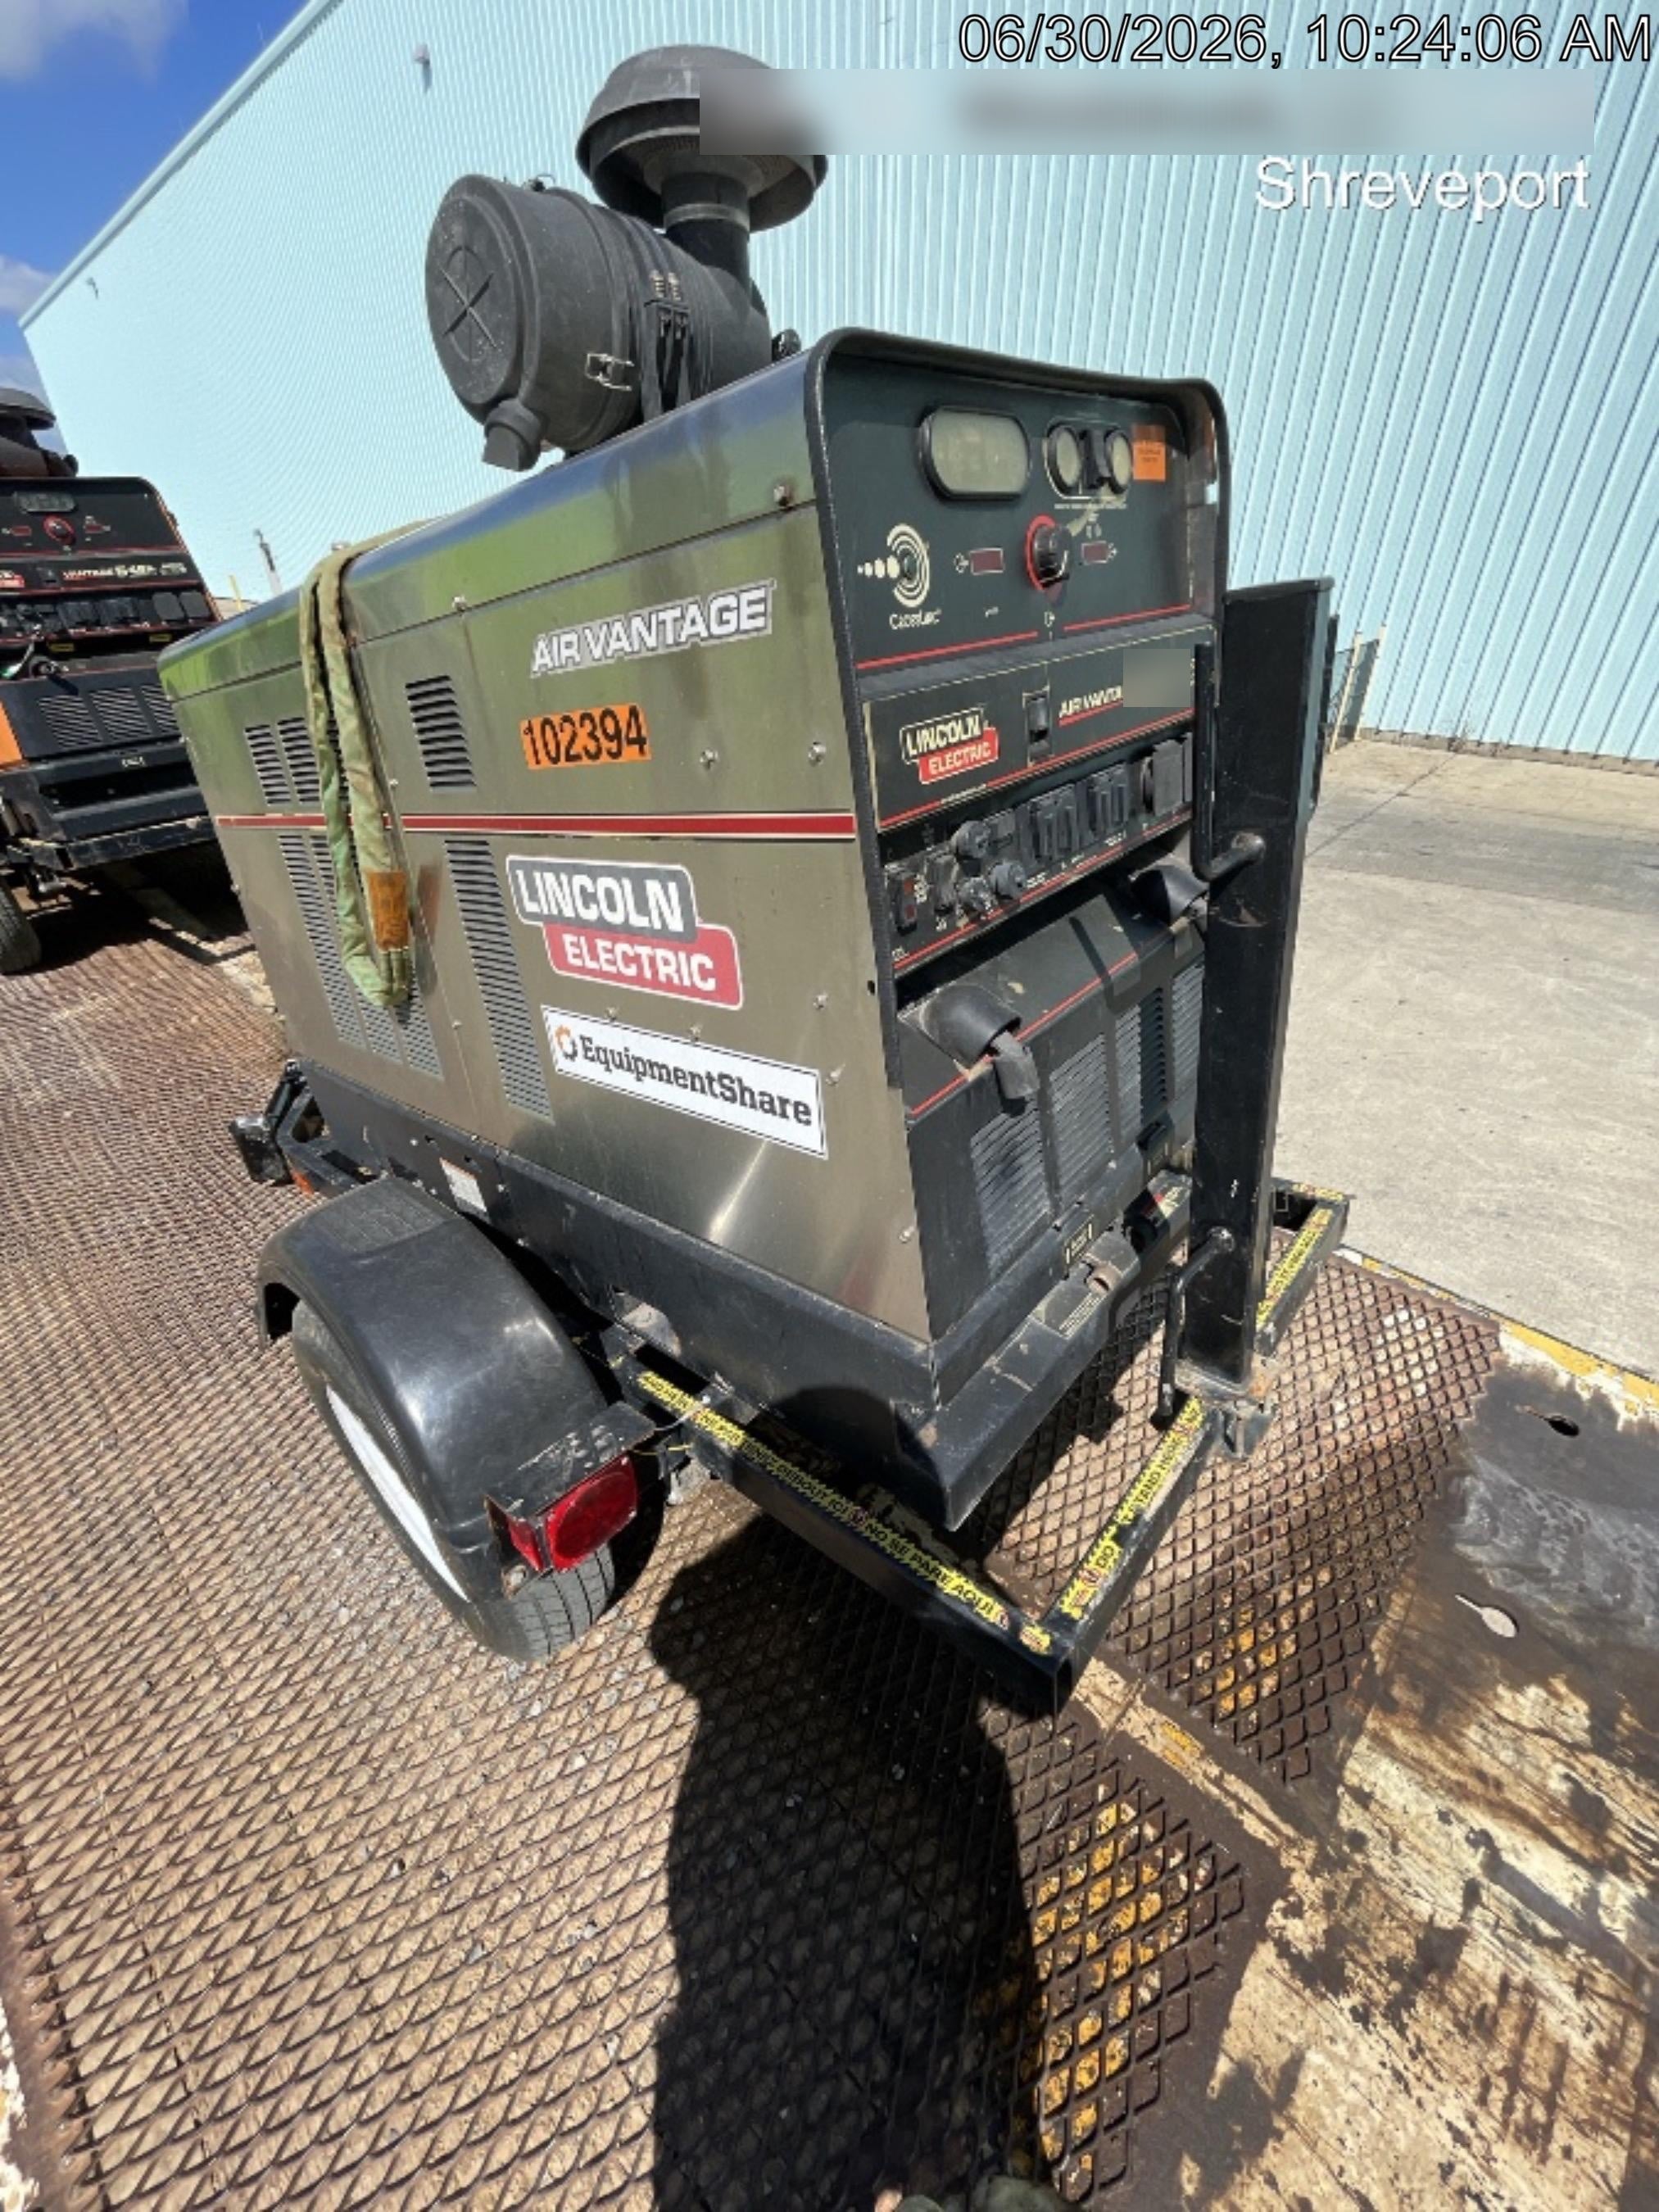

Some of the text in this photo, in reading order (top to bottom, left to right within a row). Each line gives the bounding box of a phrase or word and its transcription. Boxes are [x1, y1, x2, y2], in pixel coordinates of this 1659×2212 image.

[533, 587, 767, 672] AIR VANTAGE
[524, 705, 647, 764] 102394
[907, 714, 981, 753] LINCOLN
[928, 741, 992, 775] ELECTRIC
[515, 869, 684, 932] LINCOLN
[563, 934, 716, 991] ELECTRIC
[580, 1035, 812, 1126] EquipmentShare
